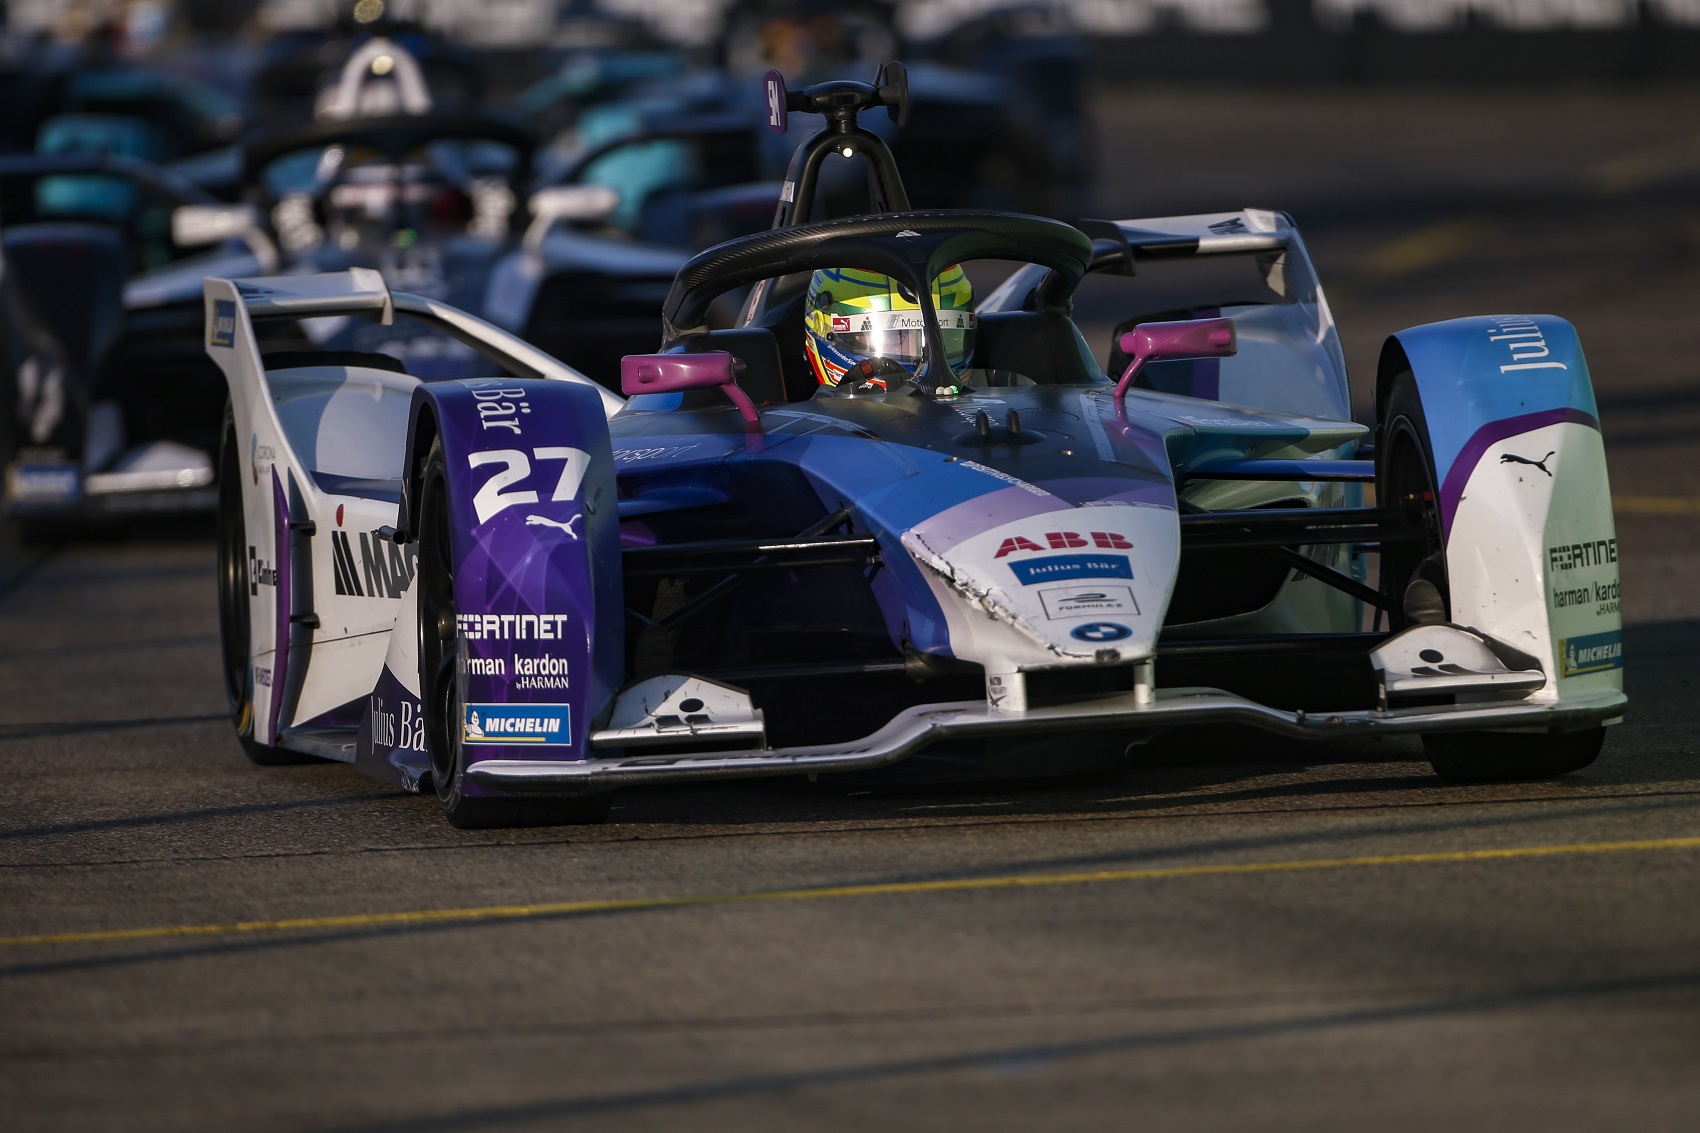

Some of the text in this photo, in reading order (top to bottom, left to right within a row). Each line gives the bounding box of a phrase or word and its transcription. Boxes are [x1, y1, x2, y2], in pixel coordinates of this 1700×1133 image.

[471, 387, 532, 435] Bär
[467, 446, 592, 526] 27
[993, 531, 1134, 559] ABB
[1549, 538, 1618, 571] FORTINE
[359, 531, 419, 599] MAG
[1028, 561, 1120, 576] Julius Bär
[455, 614, 568, 640] FORTINET
[514, 653, 569, 675] kardon
[1578, 642, 1622, 664] MICHELIN
[521, 676, 569, 689] HARMAN
[371, 695, 427, 754] Julius Bä
[485, 717, 561, 733] MICHELIN
